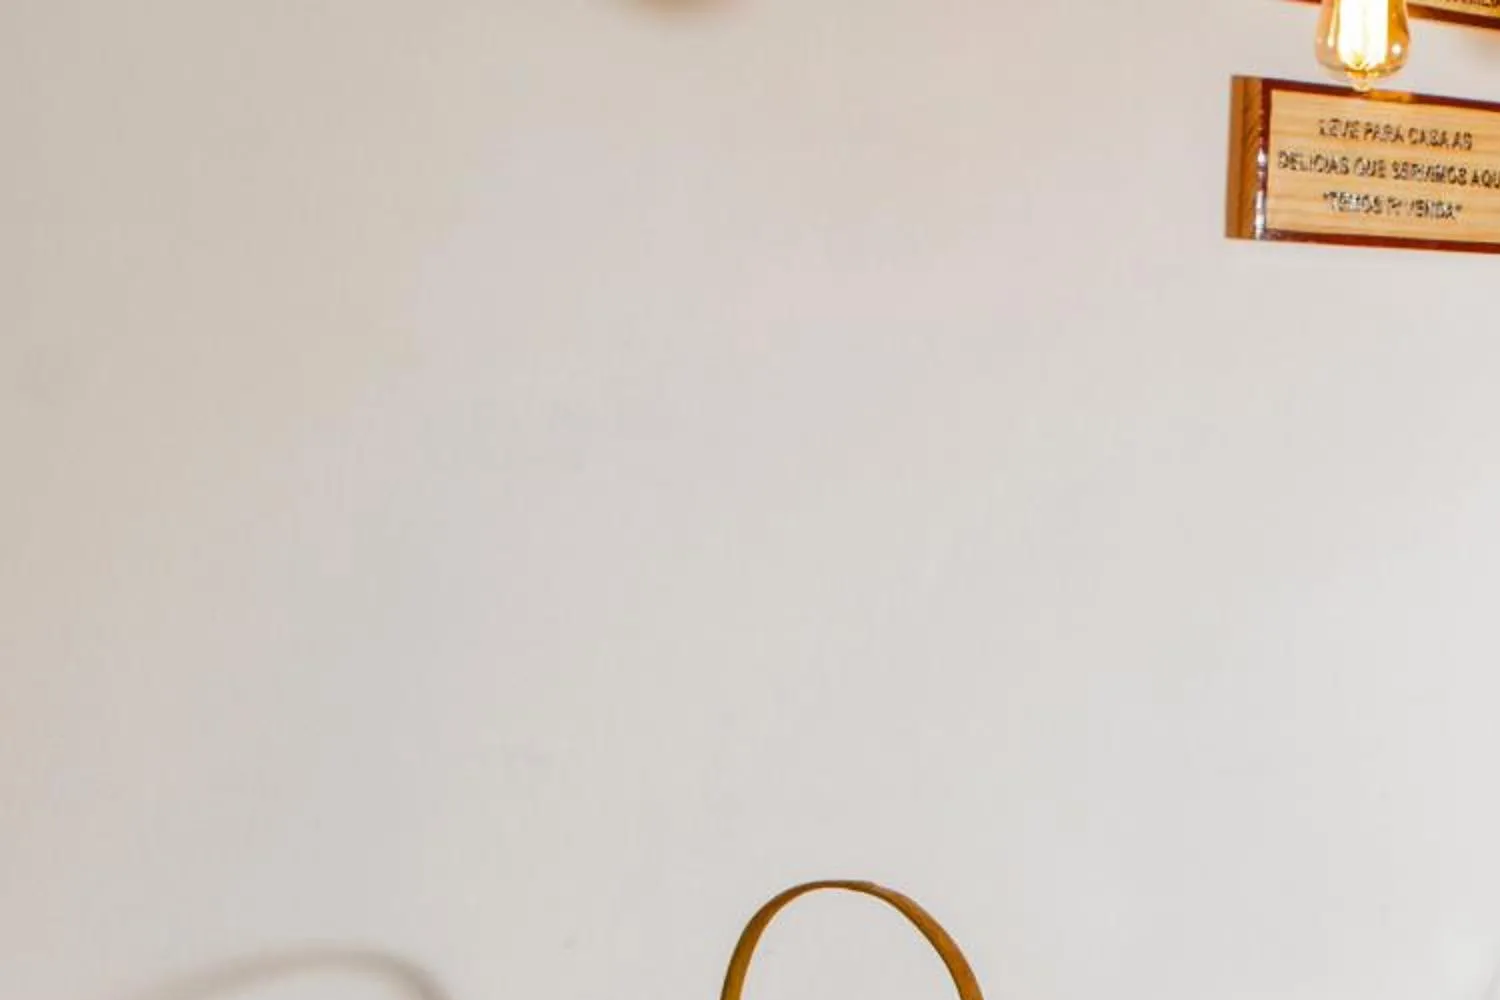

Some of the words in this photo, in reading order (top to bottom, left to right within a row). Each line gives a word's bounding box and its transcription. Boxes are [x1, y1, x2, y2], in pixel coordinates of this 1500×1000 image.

[1318, 118, 1360, 139] LEVE
[1363, 122, 1405, 144] PARA
[1407, 127, 1449, 148] CASA
[1451, 131, 1473, 151] AS
[1354, 156, 1386, 178] QUE
